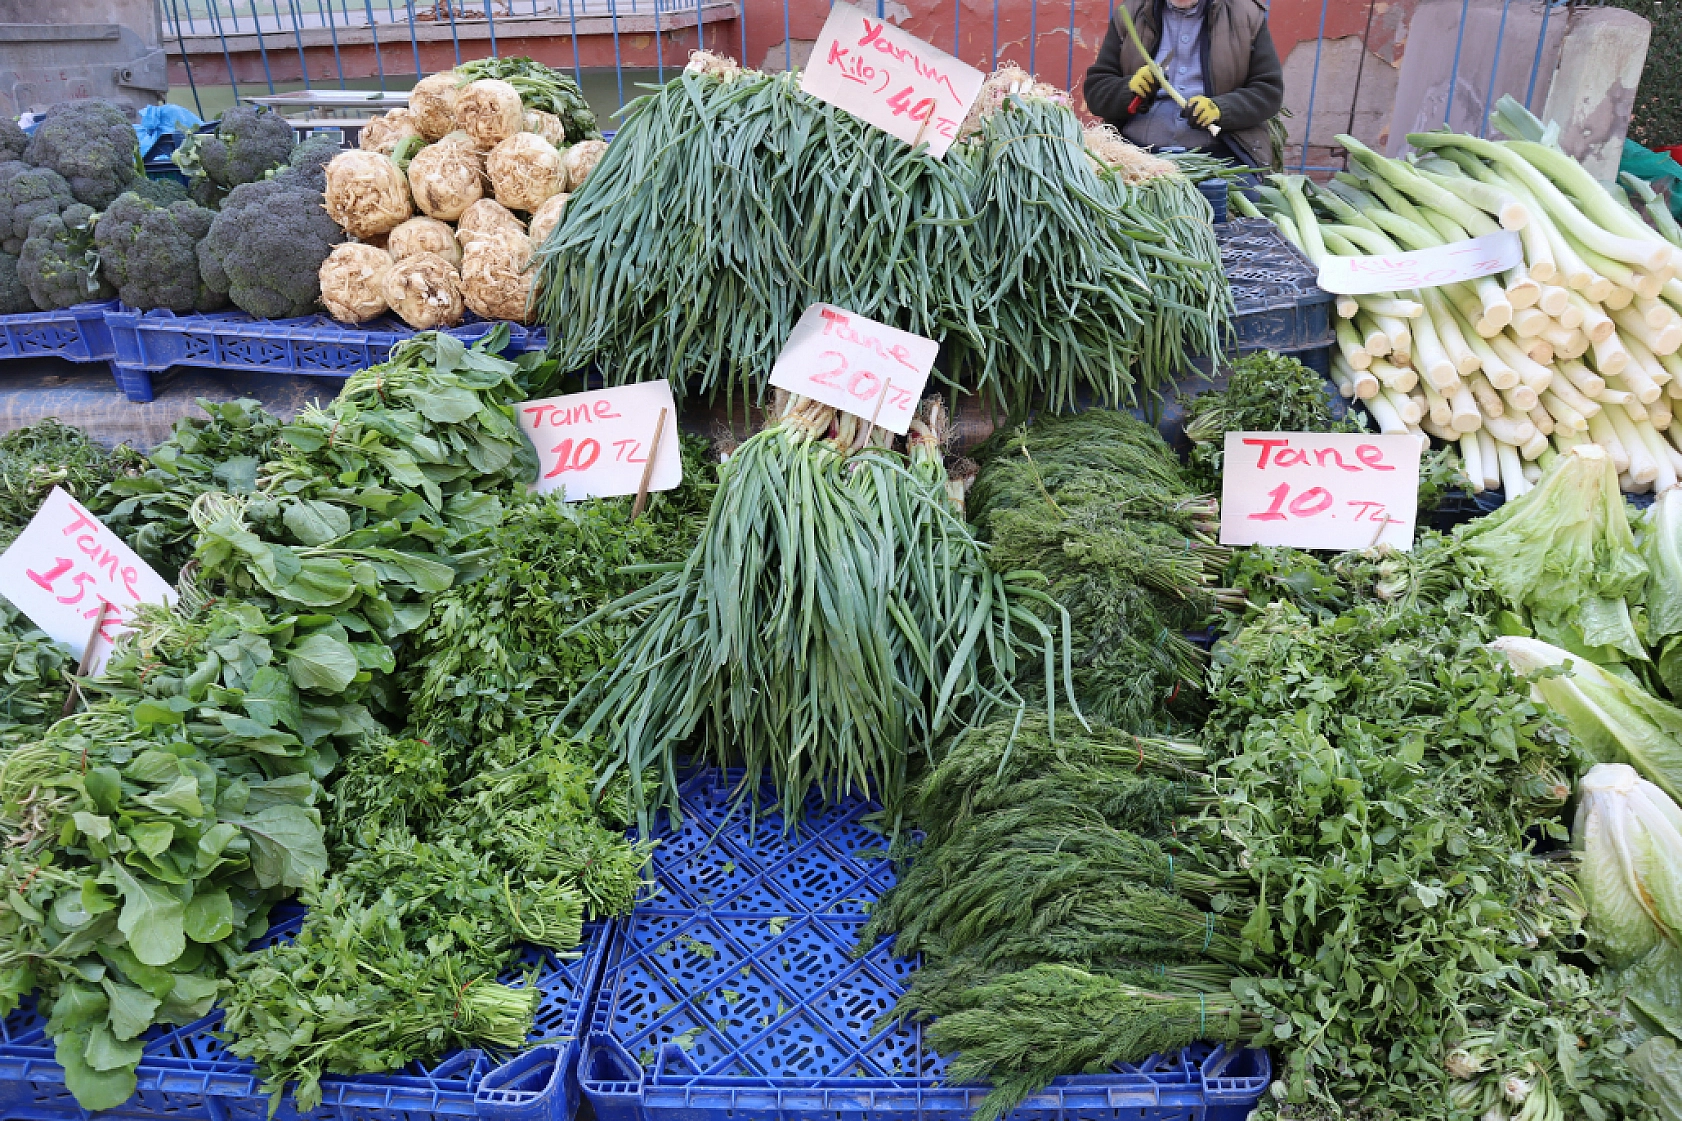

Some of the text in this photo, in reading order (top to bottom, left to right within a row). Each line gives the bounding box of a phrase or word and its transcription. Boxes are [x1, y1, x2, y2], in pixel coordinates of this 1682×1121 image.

[886, 86, 936, 126] 40
[936, 117, 958, 139] TL
[819, 308, 919, 373] Tane
[809, 351, 913, 411] 20 TL
[523, 400, 621, 428] Tane
[544, 438, 648, 479] 10 TL
[1242, 438, 1396, 472] Tane
[1347, 500, 1405, 524] TL
[62, 503, 141, 601] Tane
